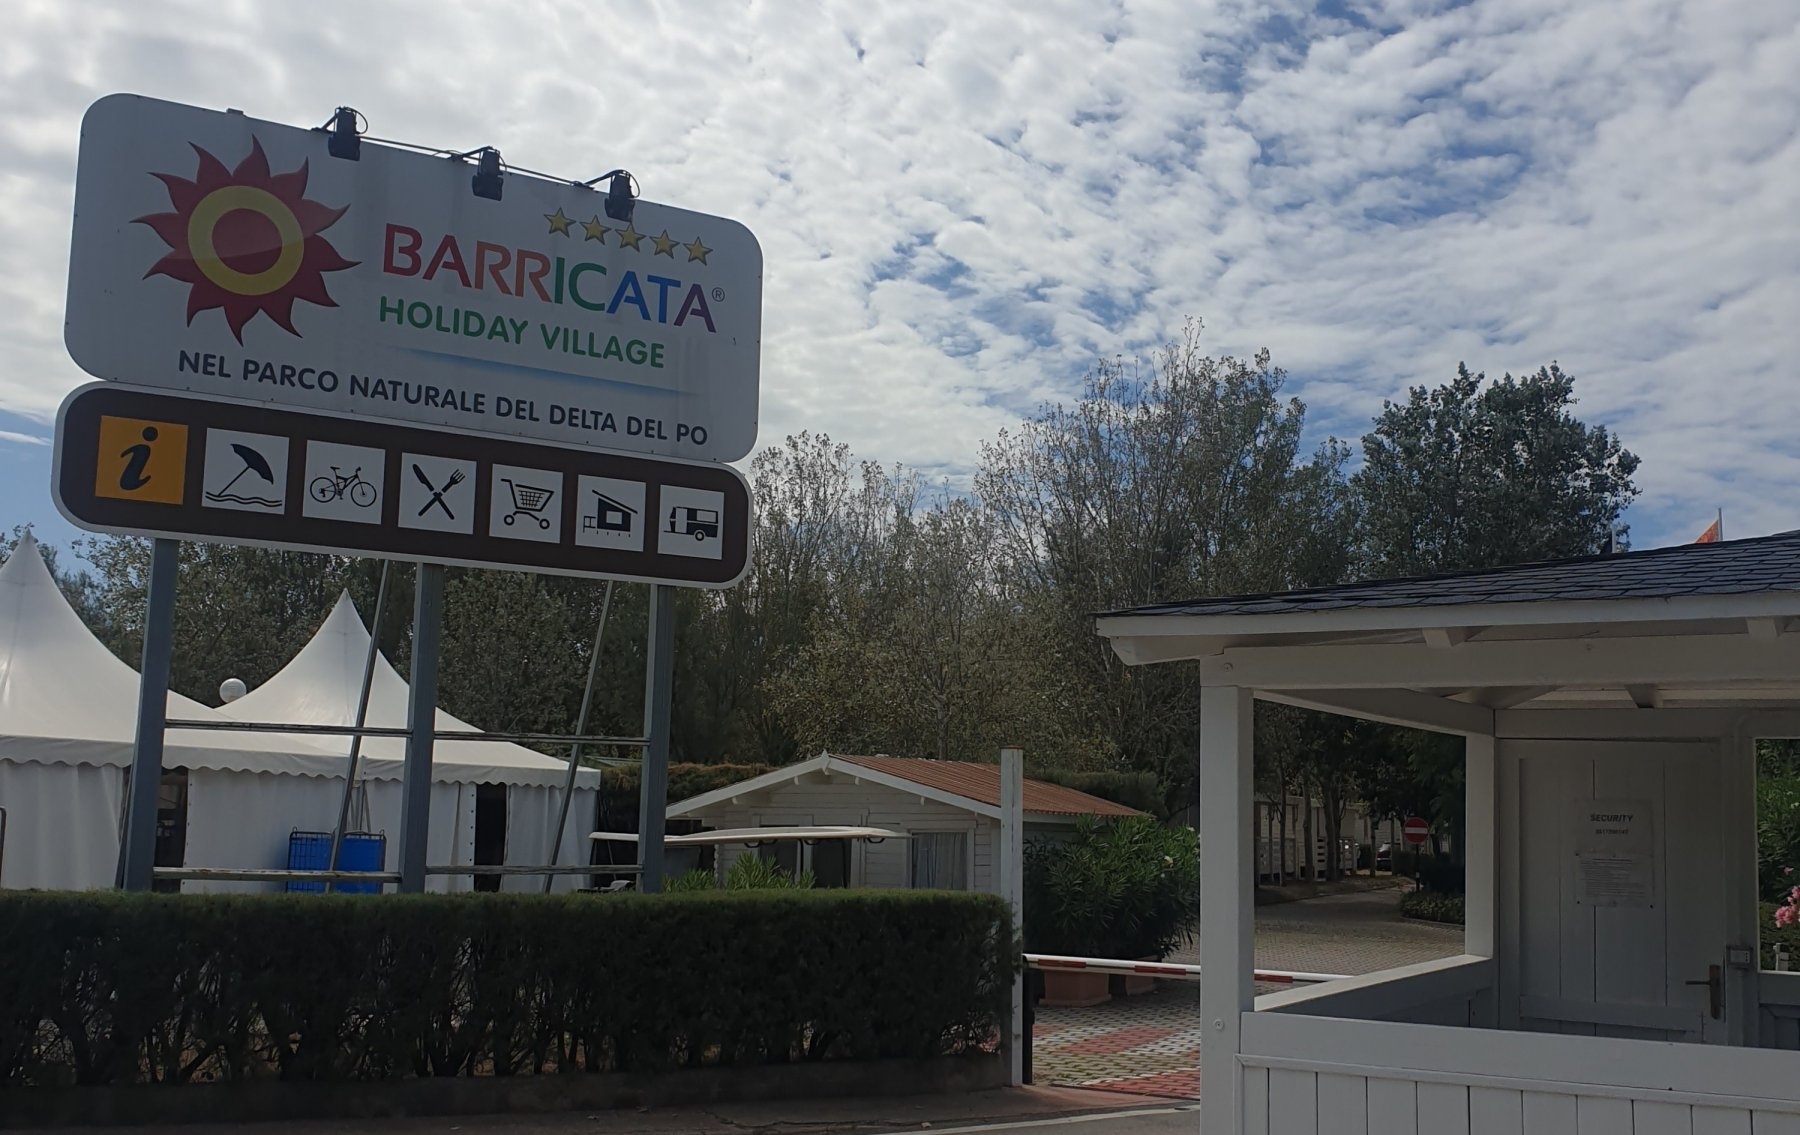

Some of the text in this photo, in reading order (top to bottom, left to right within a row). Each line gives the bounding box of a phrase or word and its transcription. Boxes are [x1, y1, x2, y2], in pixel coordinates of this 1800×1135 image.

[380, 296, 665, 368] HOLIDAY VILLAGE
[179, 350, 708, 445] NEL PARCO NATURALE DEL DELTA DEL PO
[1590, 814, 1634, 823] SECURITY
